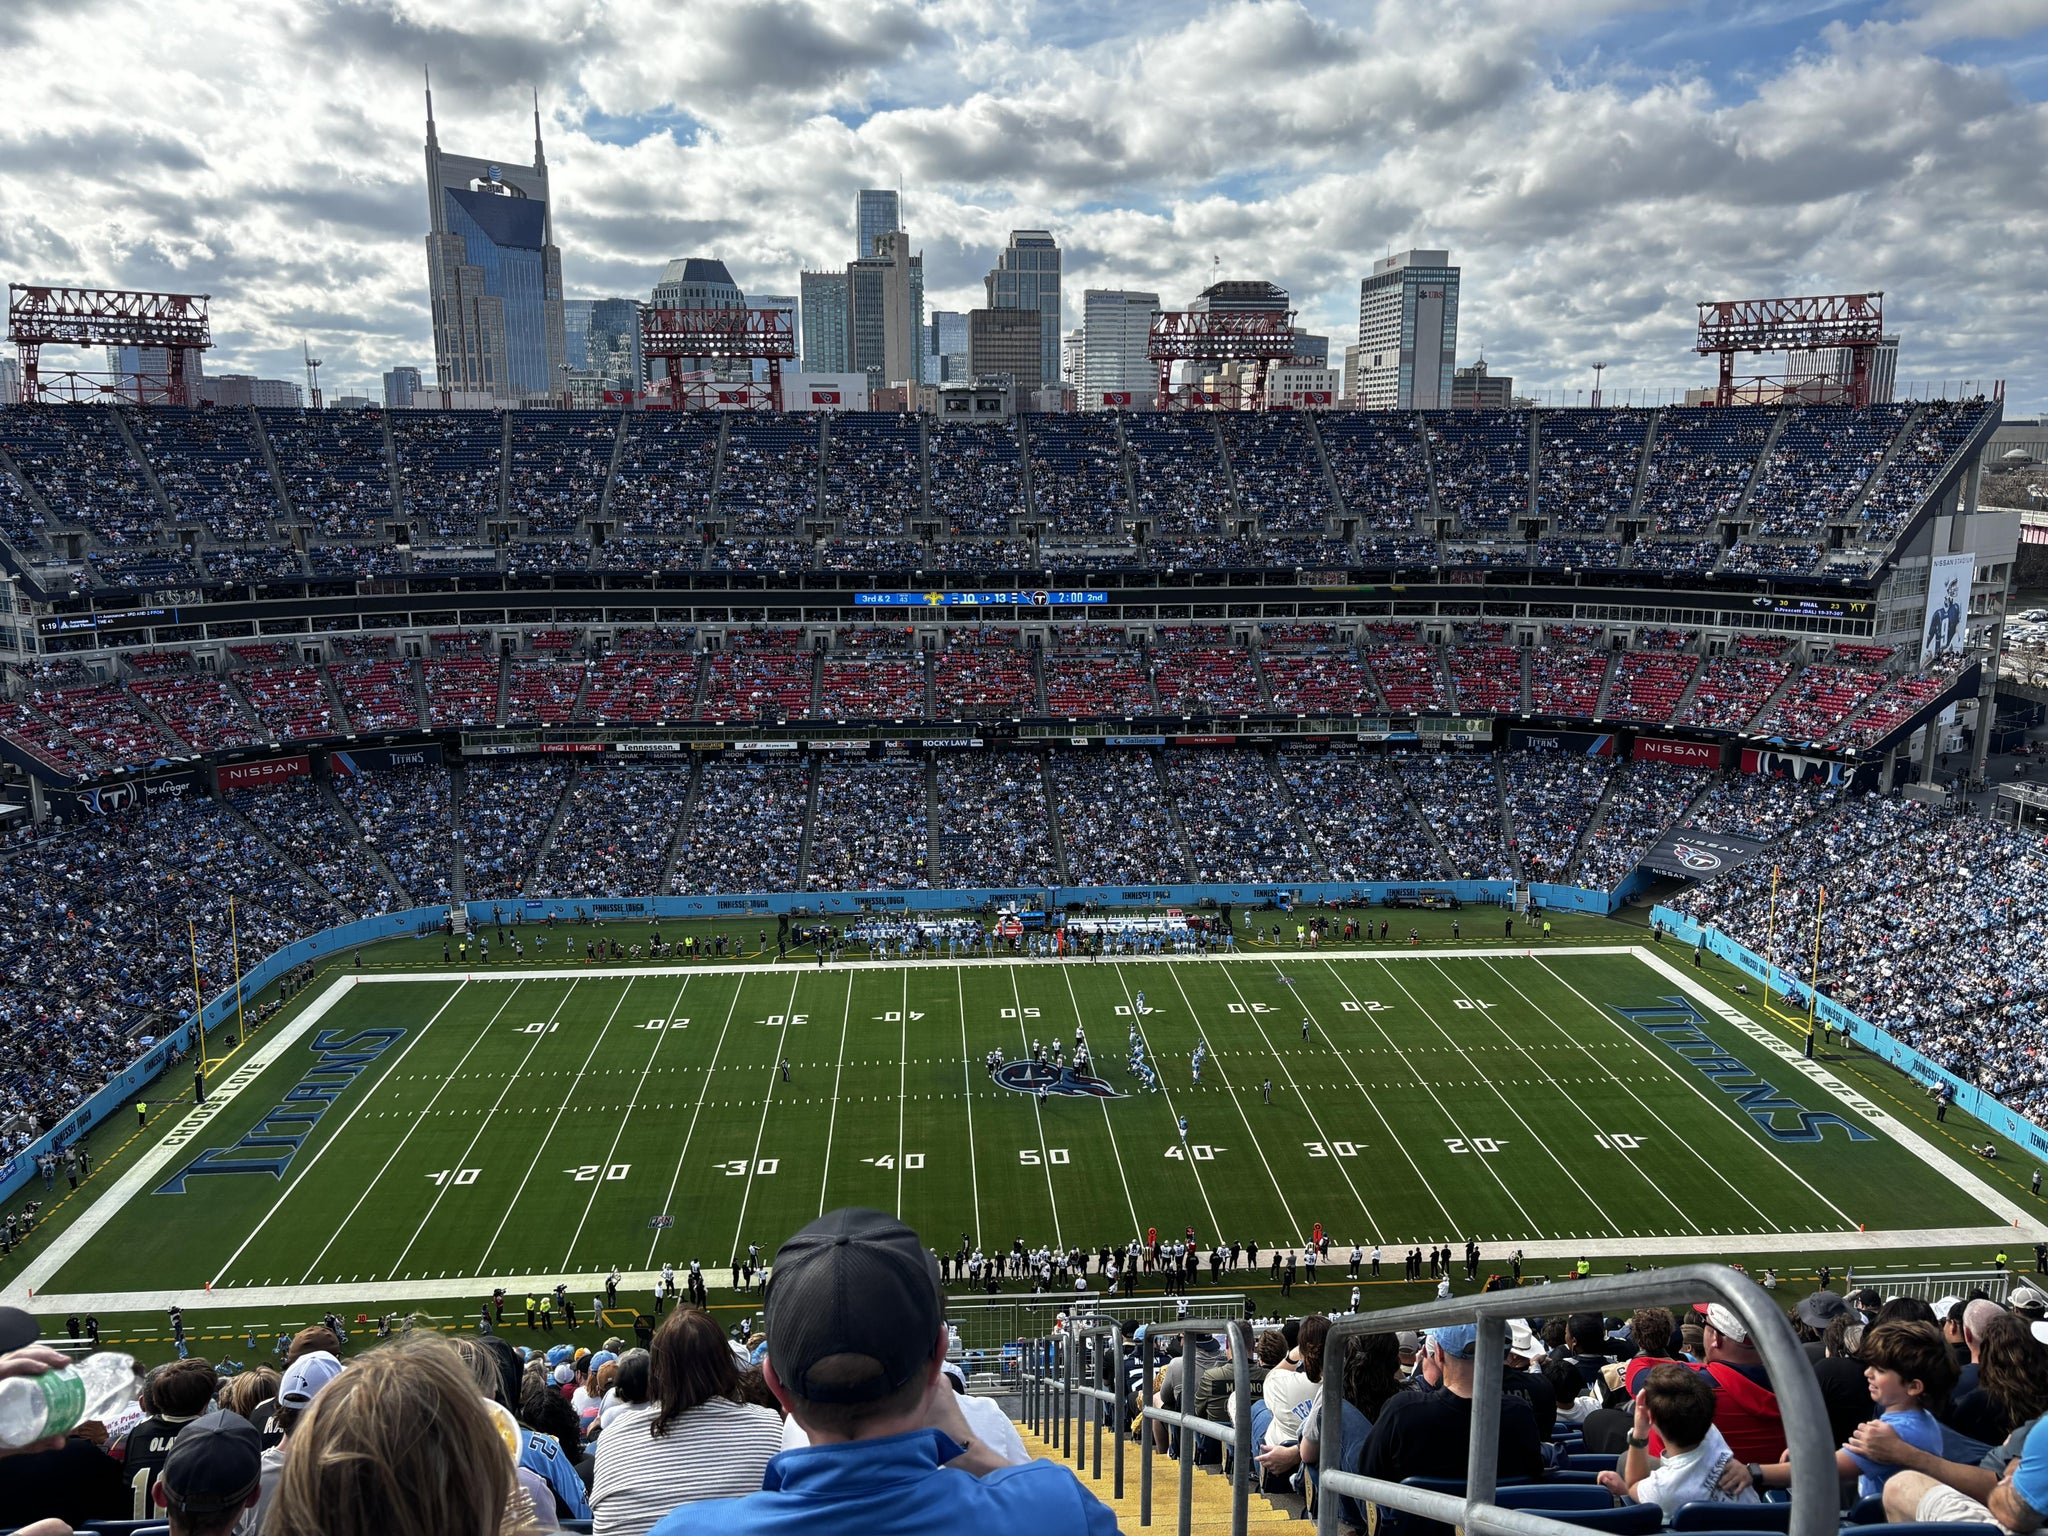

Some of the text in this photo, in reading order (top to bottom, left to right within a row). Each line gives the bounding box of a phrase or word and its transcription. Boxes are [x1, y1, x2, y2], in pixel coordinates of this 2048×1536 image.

[1429, 290, 1444, 299] UBS
[1933, 558, 1954, 567] NISSAN
[862, 595, 877, 603] 3rd
[962, 593, 976, 603] 10
[994, 593, 1007, 603] 13
[1058, 592, 1103, 603] 2:00 2nd
[41, 622, 57, 631] 1:19
[885, 740, 906, 748] FedEx
[1526, 735, 1559, 748] TITANS
[1645, 742, 1710, 758] NISSAN
[389, 751, 424, 766] TITANS
[230, 761, 299, 779] NISSAN
[158, 780, 191, 797] Kroger
[1677, 836, 1745, 854] NISSAN
[1652, 868, 1686, 880] NISSAN
[855, 896, 905, 906] TENNESSEE TOUGH
[592, 903, 645, 913] TENNESSEE TOUGH
[1227, 1002, 1272, 1014] 30
[1340, 1001, 1385, 1012] 20
[1452, 999, 1489, 1010] 10
[884, 1011, 926, 1022] 40
[1000, 1007, 1041, 1019] 50
[1821, 1002, 1843, 1025] TENNESSEE
[644, 1018, 691, 1030] 20
[765, 1014, 809, 1026] 30
[523, 1022, 560, 1034] 10
[1603, 995, 1878, 1143] TITANS
[1717, 1008, 1886, 1118] IT TAKES ALL OF US
[162, 1063, 266, 1146] CHOOSE LOVE
[151, 1028, 409, 1195] TITANS
[1443, 1137, 1500, 1153] 20
[1593, 1133, 1641, 1149] 10
[1164, 1145, 1216, 1161] 40
[1303, 1141, 1359, 1157] 30
[874, 1153, 926, 1170] 40
[1019, 1148, 1070, 1165] 50
[574, 1163, 633, 1181] 20
[725, 1158, 781, 1176] 30
[434, 1168, 483, 1186] 10
[120, 1412, 141, 1424] Pride
[149, 1436, 178, 1453] OLA
